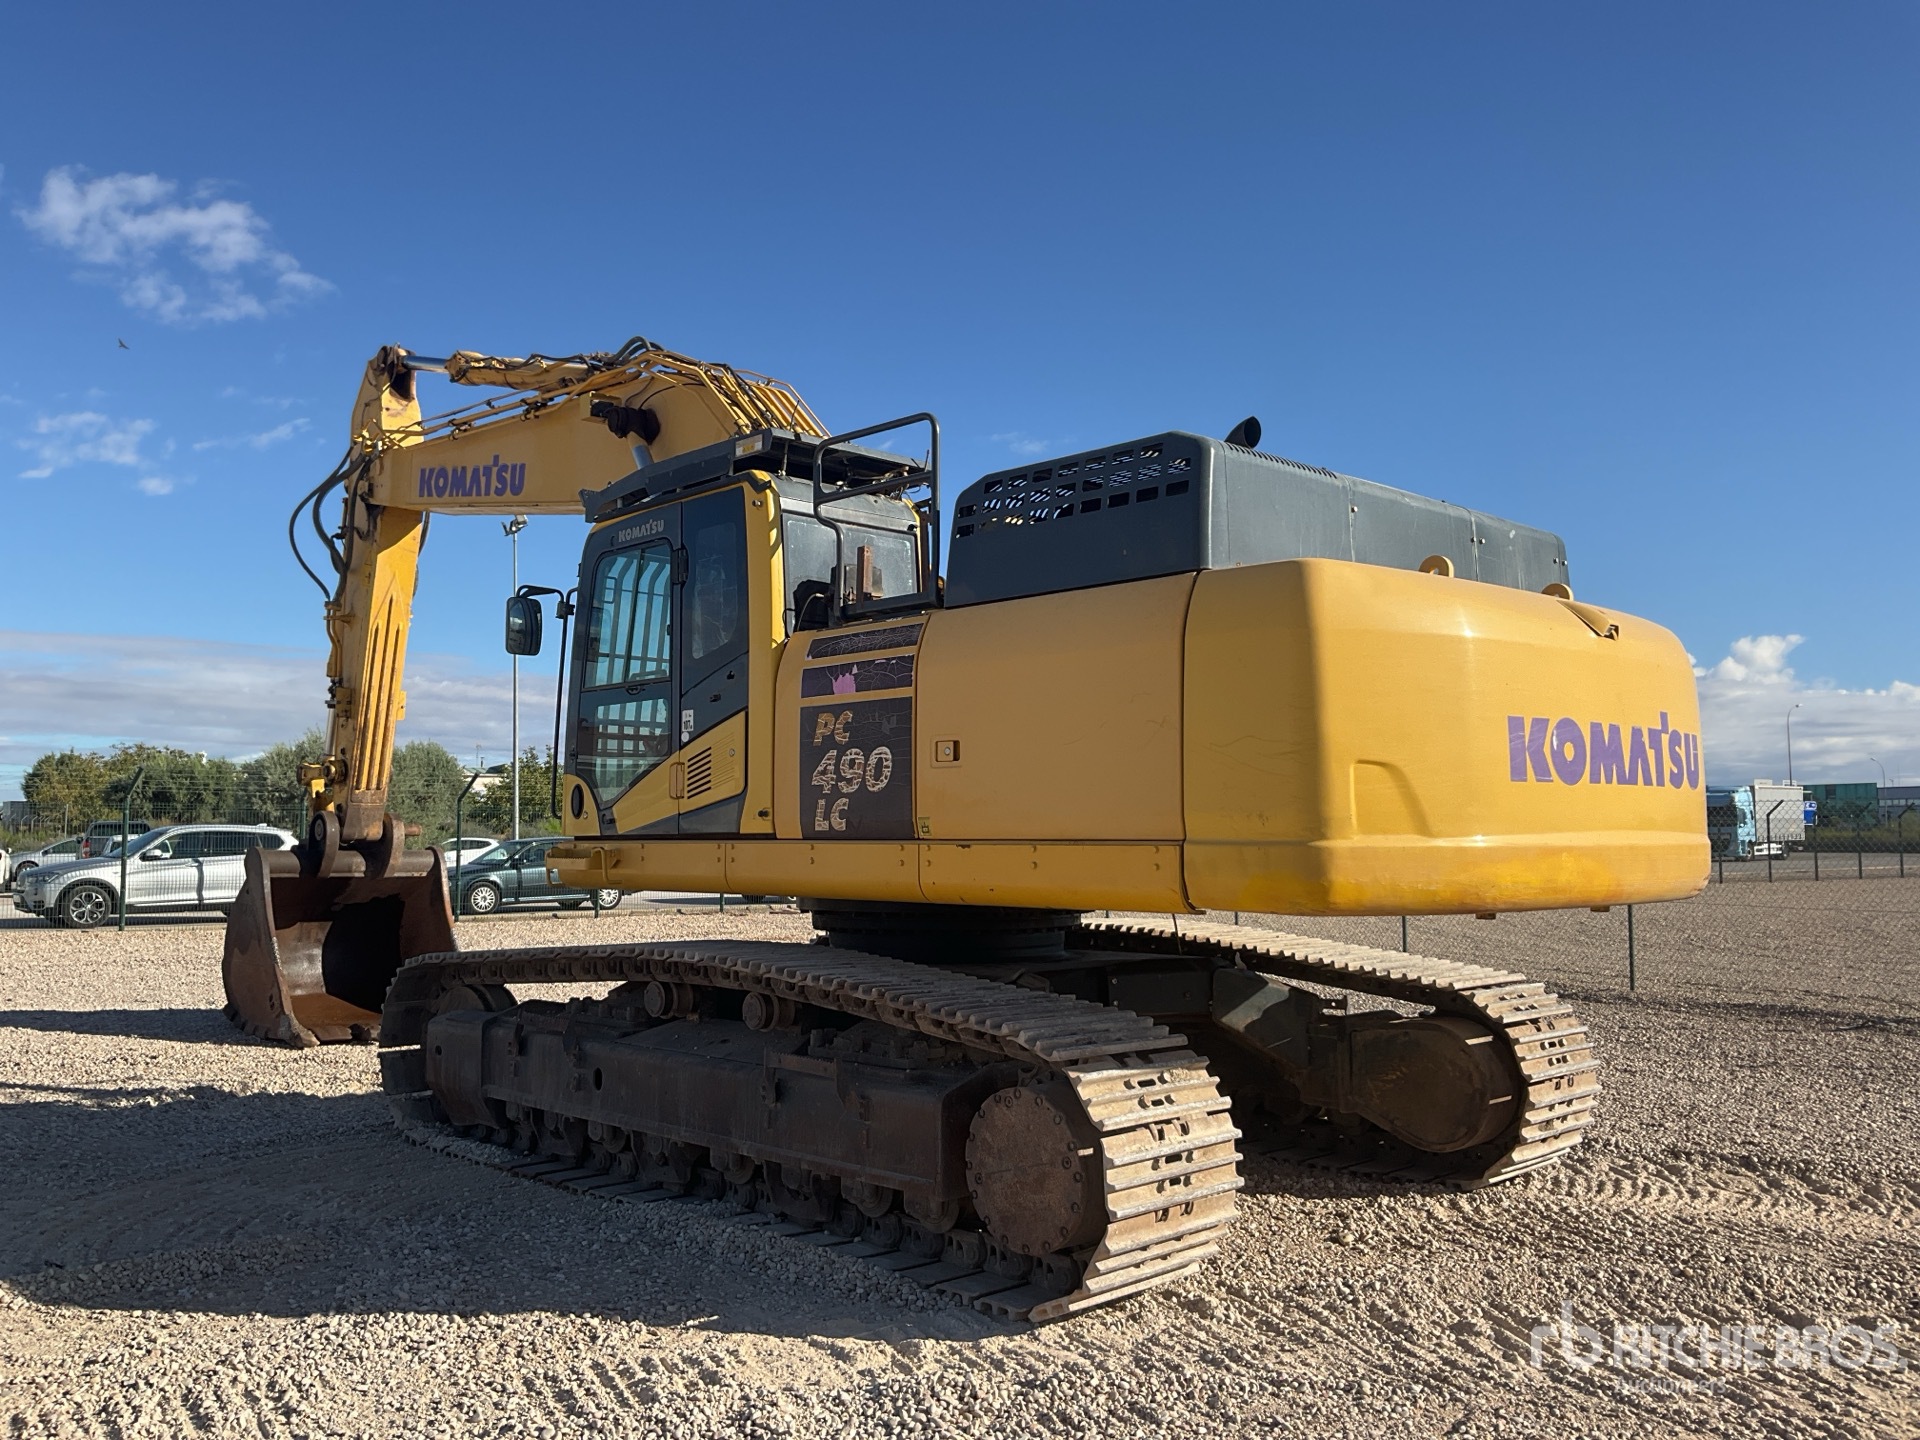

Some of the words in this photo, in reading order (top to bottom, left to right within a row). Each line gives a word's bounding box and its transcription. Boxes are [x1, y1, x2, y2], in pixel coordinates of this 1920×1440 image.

[419, 455, 526, 498] KOMATSU
[618, 519, 665, 542] KOMATSU
[813, 711, 853, 746] PC
[811, 746, 893, 793] 490
[1508, 711, 1699, 790] KOMATSU
[814, 798, 849, 831] LC
